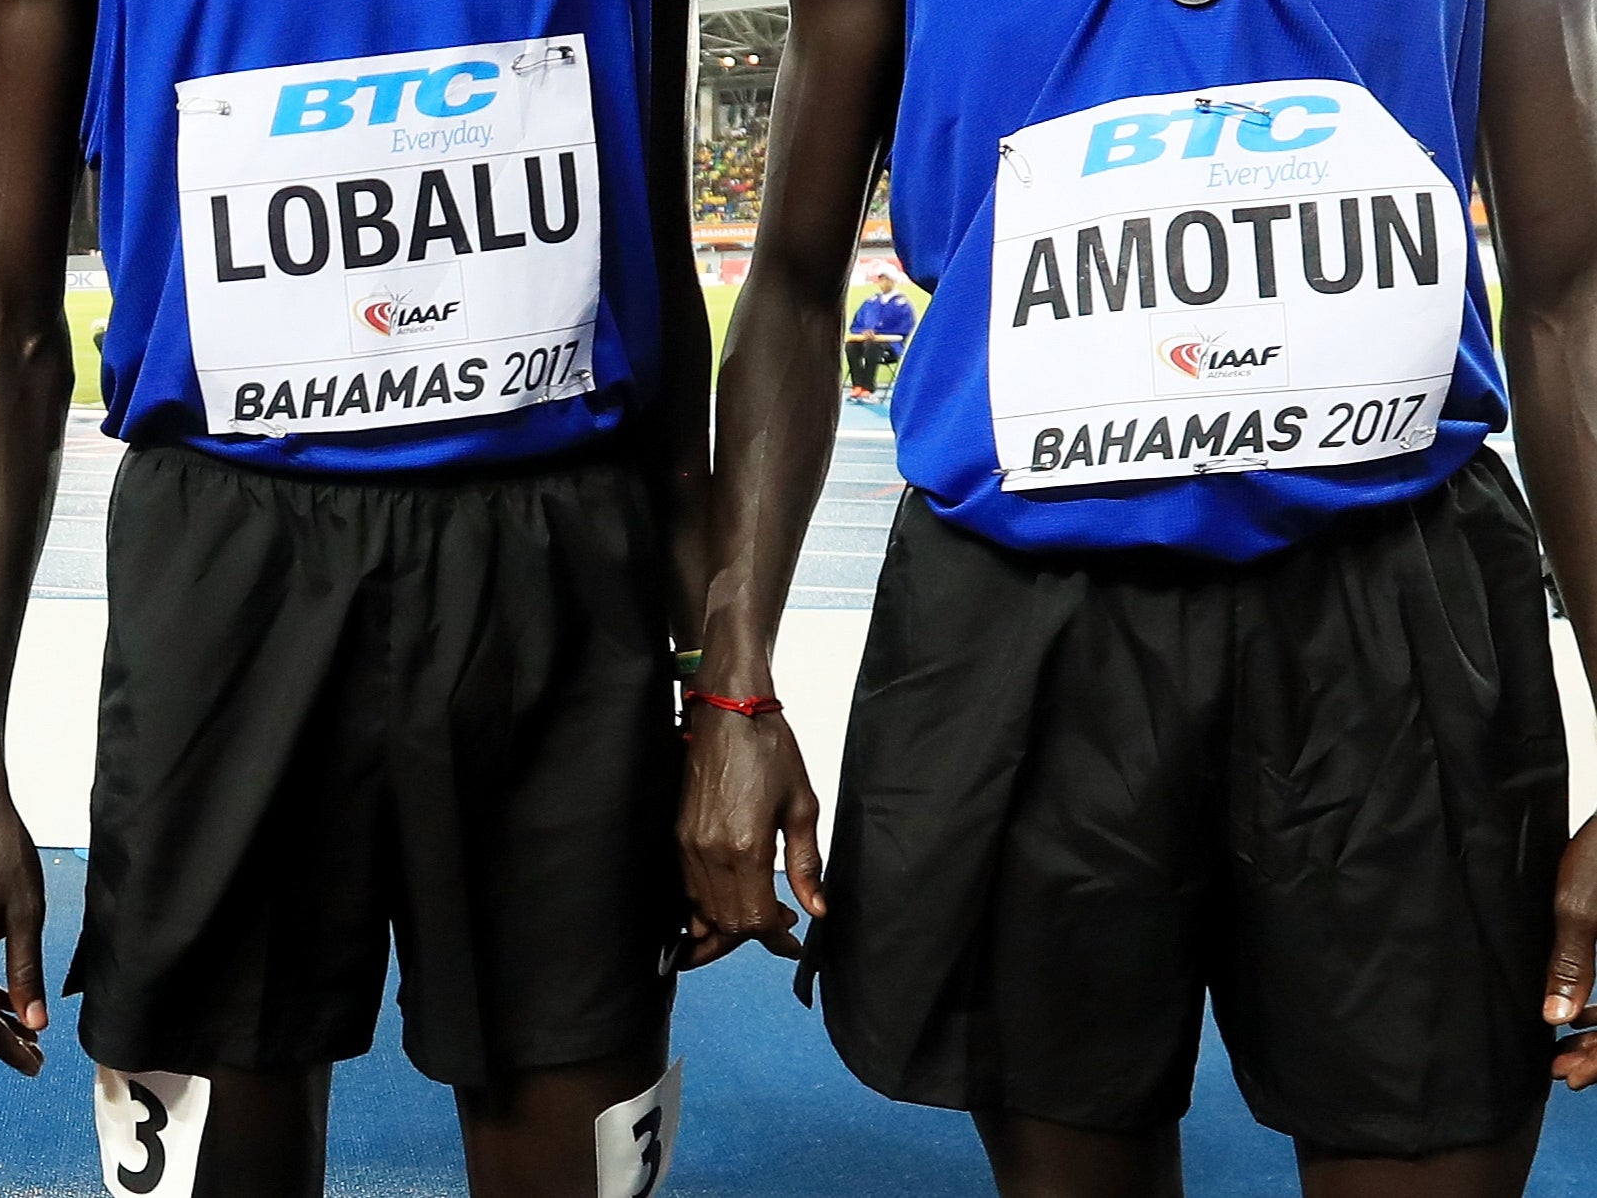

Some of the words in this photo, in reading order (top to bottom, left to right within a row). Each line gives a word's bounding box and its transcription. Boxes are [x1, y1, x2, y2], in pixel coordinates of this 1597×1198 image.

[269, 60, 501, 138] BTC
[1080, 94, 1341, 179] BTC
[210, 151, 581, 284] LOBALU
[1011, 192, 1440, 329] AMOTUN
[398, 300, 461, 326] IAAF
[233, 356, 488, 422] BAHAMAS
[500, 339, 580, 397] 2017
[1208, 345, 1283, 370] IAAF
[1030, 405, 1309, 473] BAHAMAS
[1319, 393, 1427, 451] 2017
[117, 1079, 168, 1195] 3
[631, 1105, 663, 1198] 3
